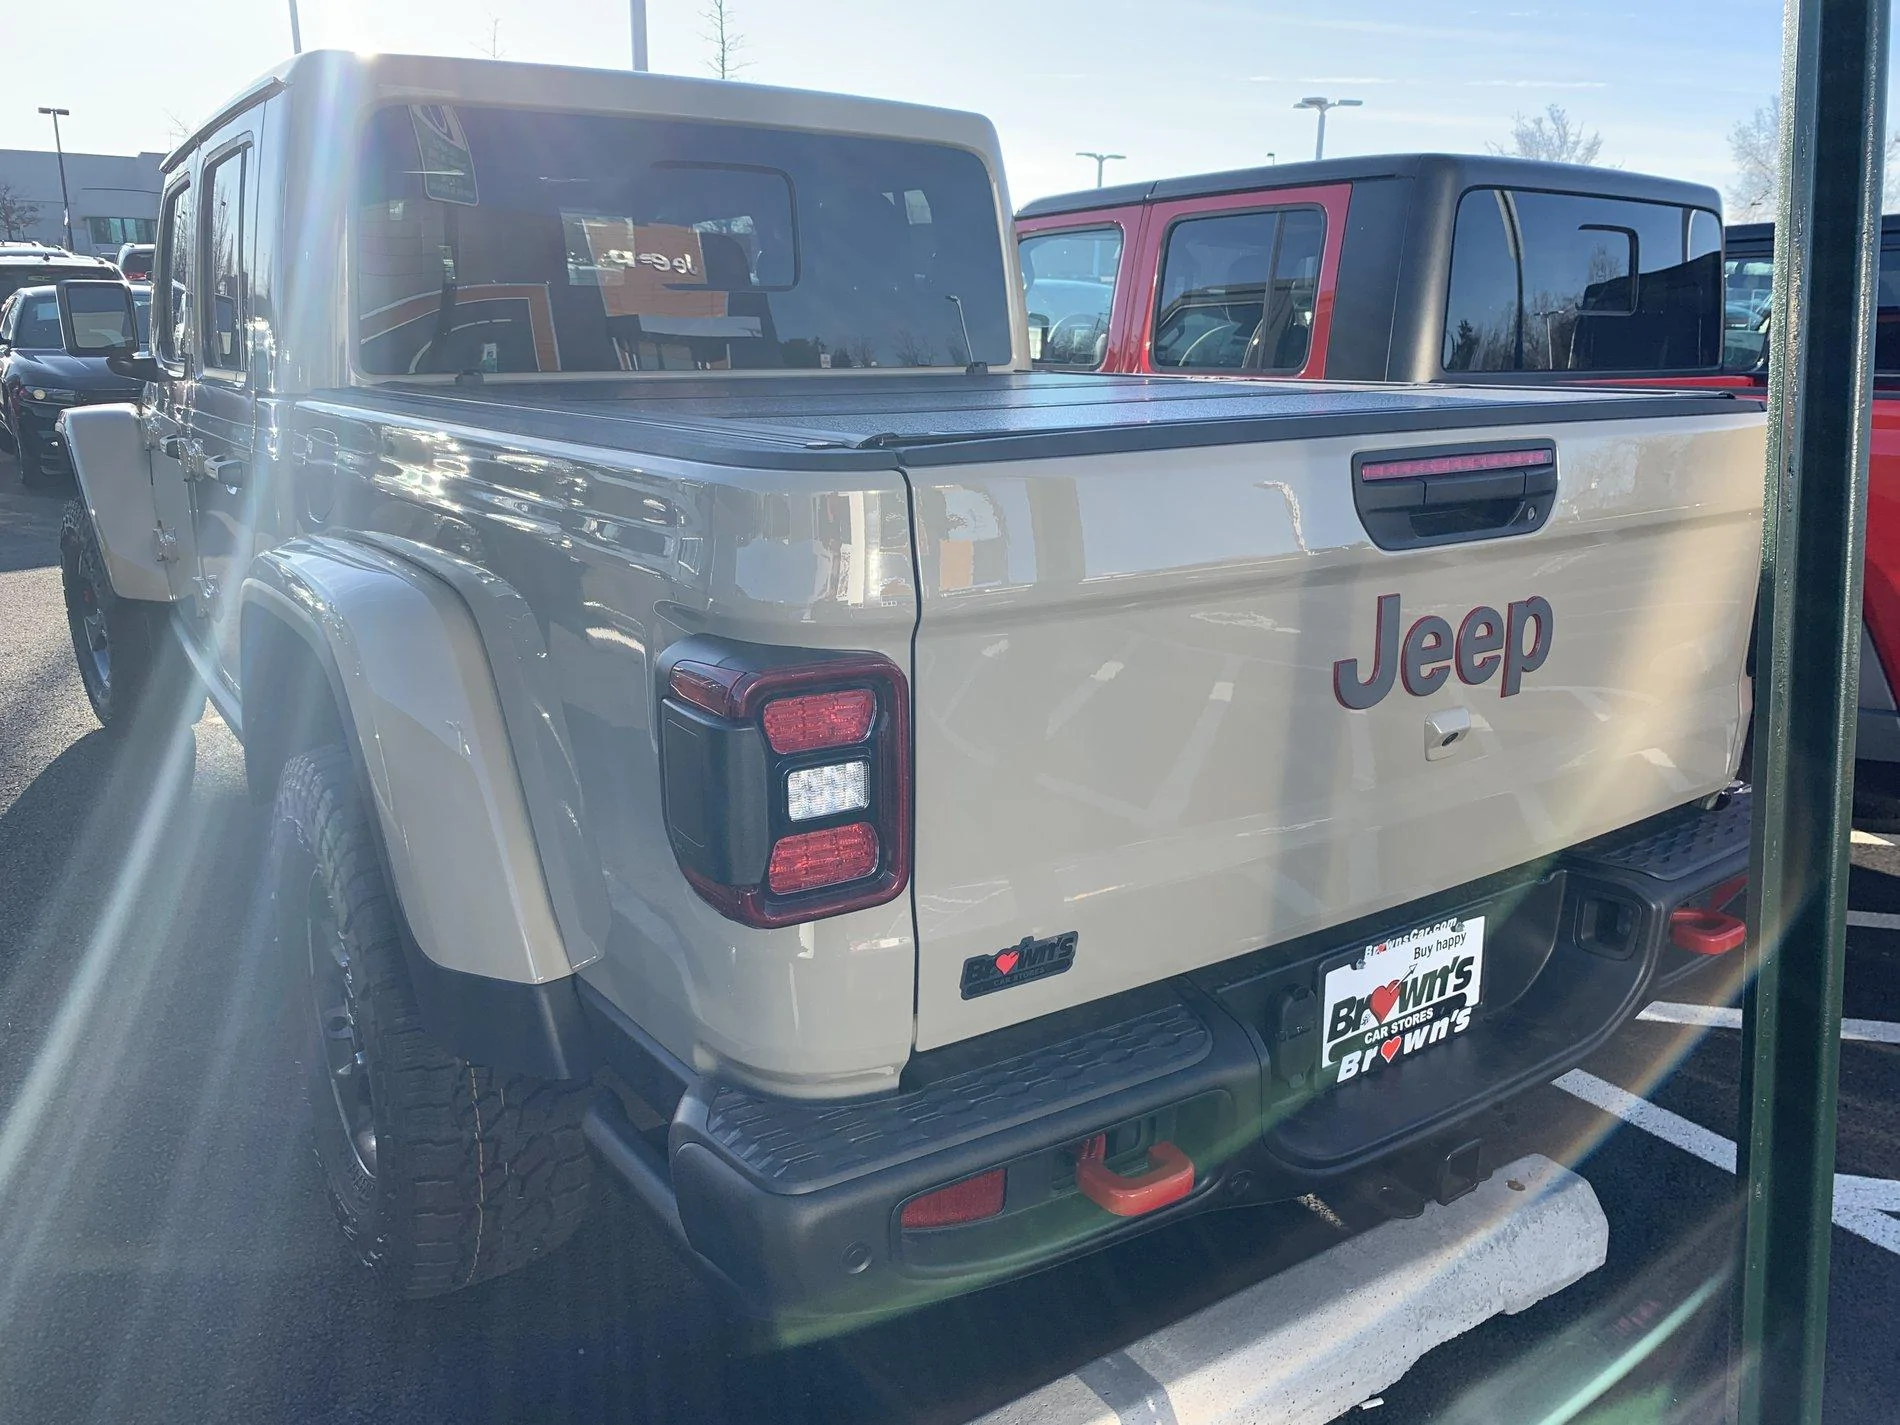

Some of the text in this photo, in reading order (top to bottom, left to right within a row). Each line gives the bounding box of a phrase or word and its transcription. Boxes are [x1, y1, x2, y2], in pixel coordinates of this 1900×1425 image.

[1333, 593, 1554, 710] Jeep
[1413, 932, 1467, 960] Buy happy
[1364, 1007, 1434, 1044] CAR STORES
